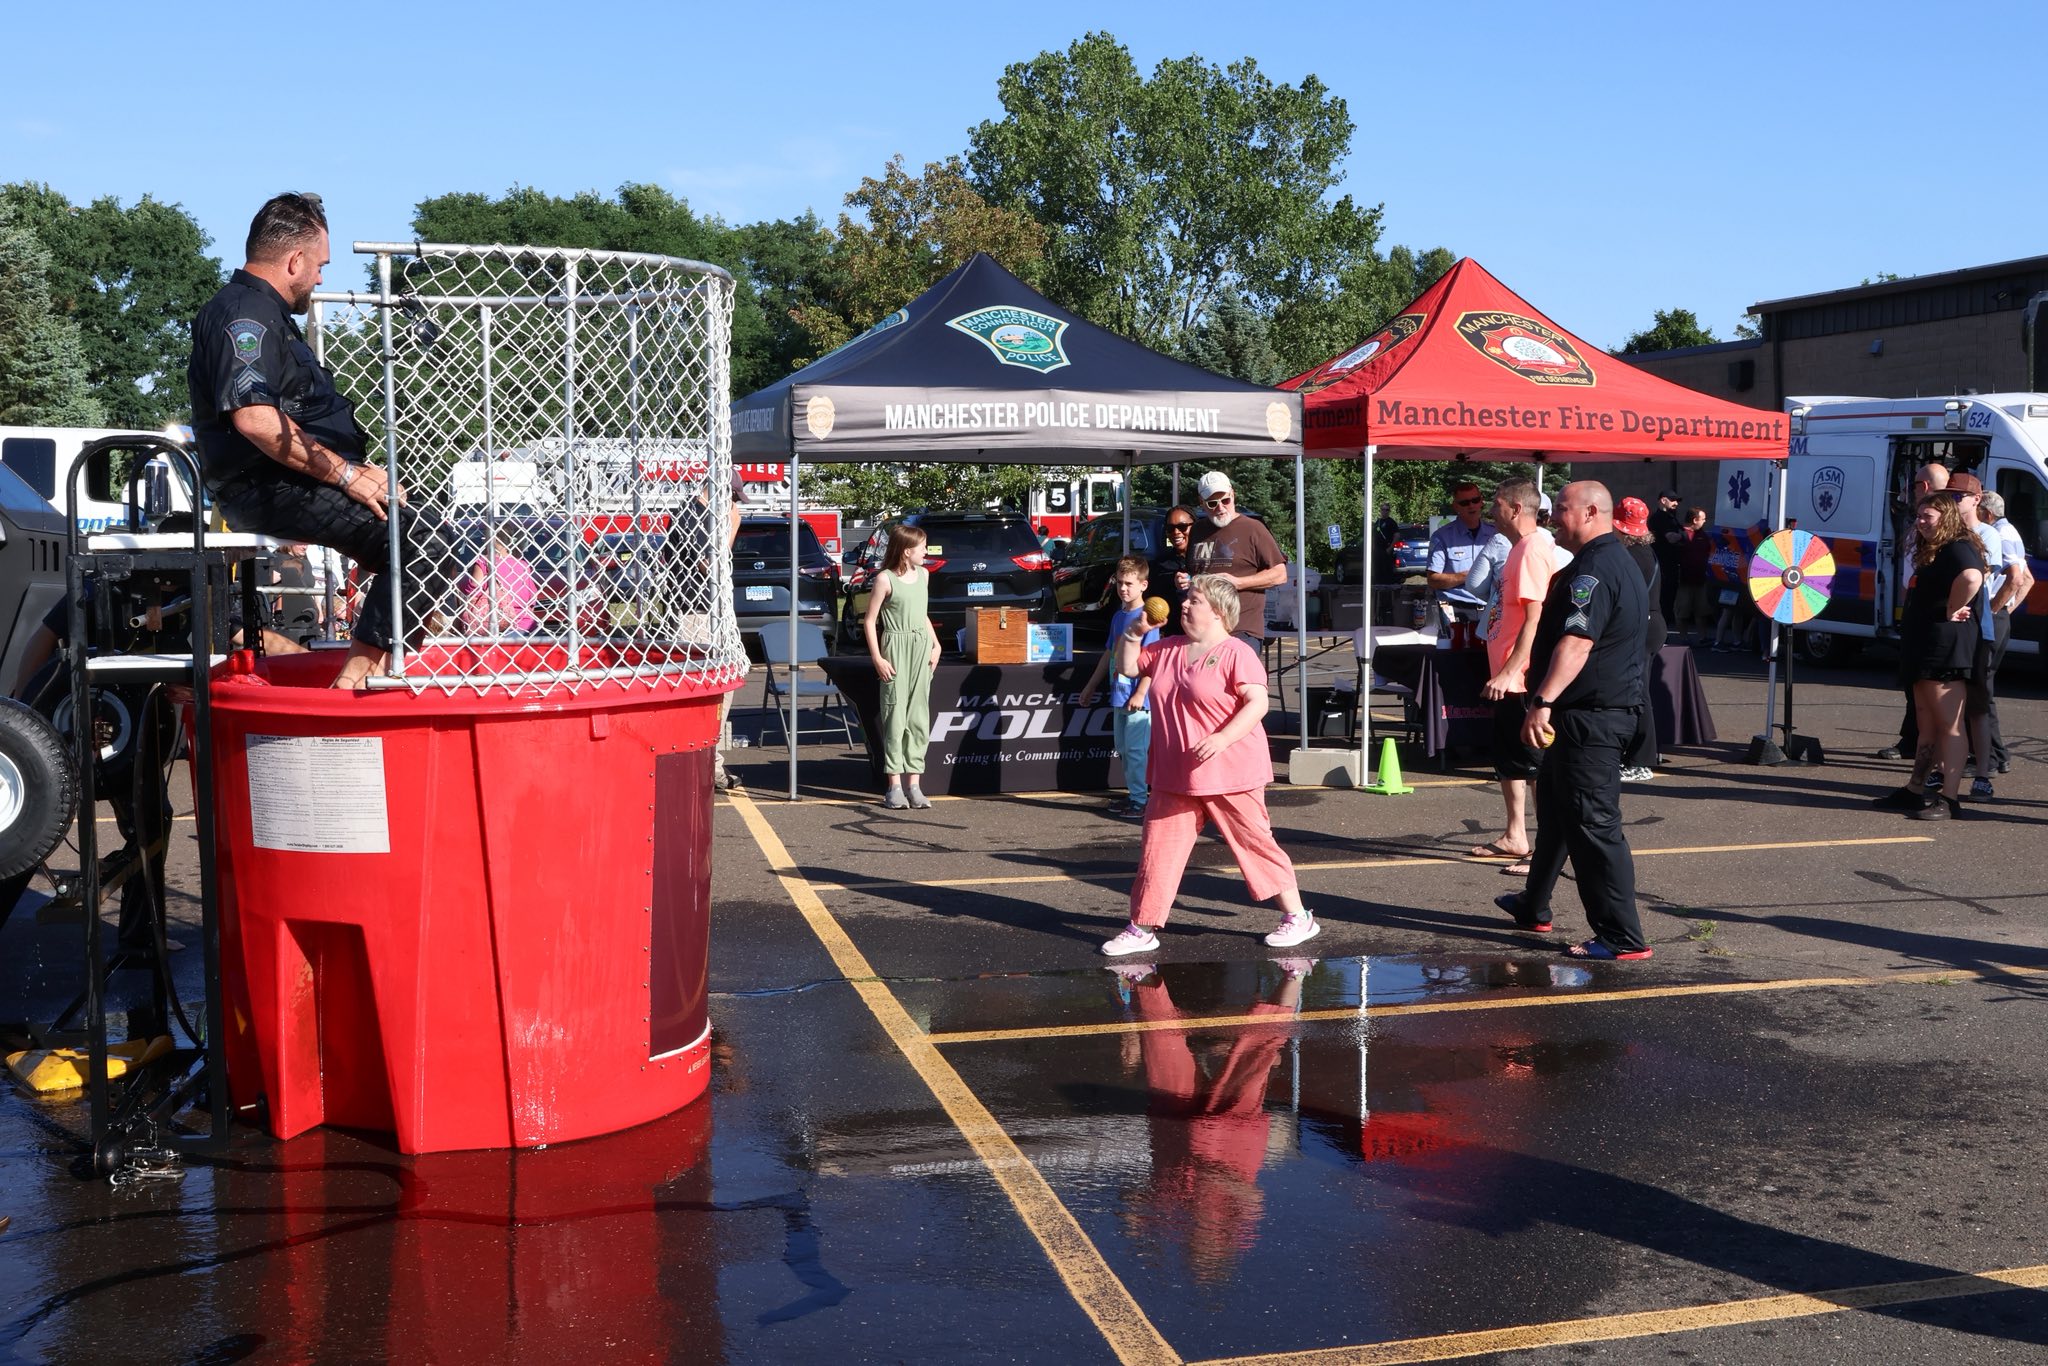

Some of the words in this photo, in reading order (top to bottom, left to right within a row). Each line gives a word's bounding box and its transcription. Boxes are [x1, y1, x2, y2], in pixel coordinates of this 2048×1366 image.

[959, 309, 1056, 328] MANCHESTER
[970, 317, 1056, 332] CONNECTICUT
[1460, 314, 1564, 343] MANCHESTER
[1005, 351, 1061, 362] POLICE
[885, 402, 1019, 430] MANCHESTER
[1024, 402, 1090, 428] POLICE
[1095, 403, 1220, 433] DEPARTMENT
[1377, 400, 1550, 429] Manchester
[1559, 406, 1614, 432] Fire
[1619, 409, 1783, 442] Department
[1969, 412, 1992, 428] 524
[1788, 437, 1811, 455] SM
[1816, 469, 1841, 484] ASM
[1051, 488, 1067, 507] 5
[943, 752, 989, 765] Serving
[992, 751, 1012, 762] the
[1015, 749, 1083, 762] Community
[1087, 748, 1119, 758] Since
